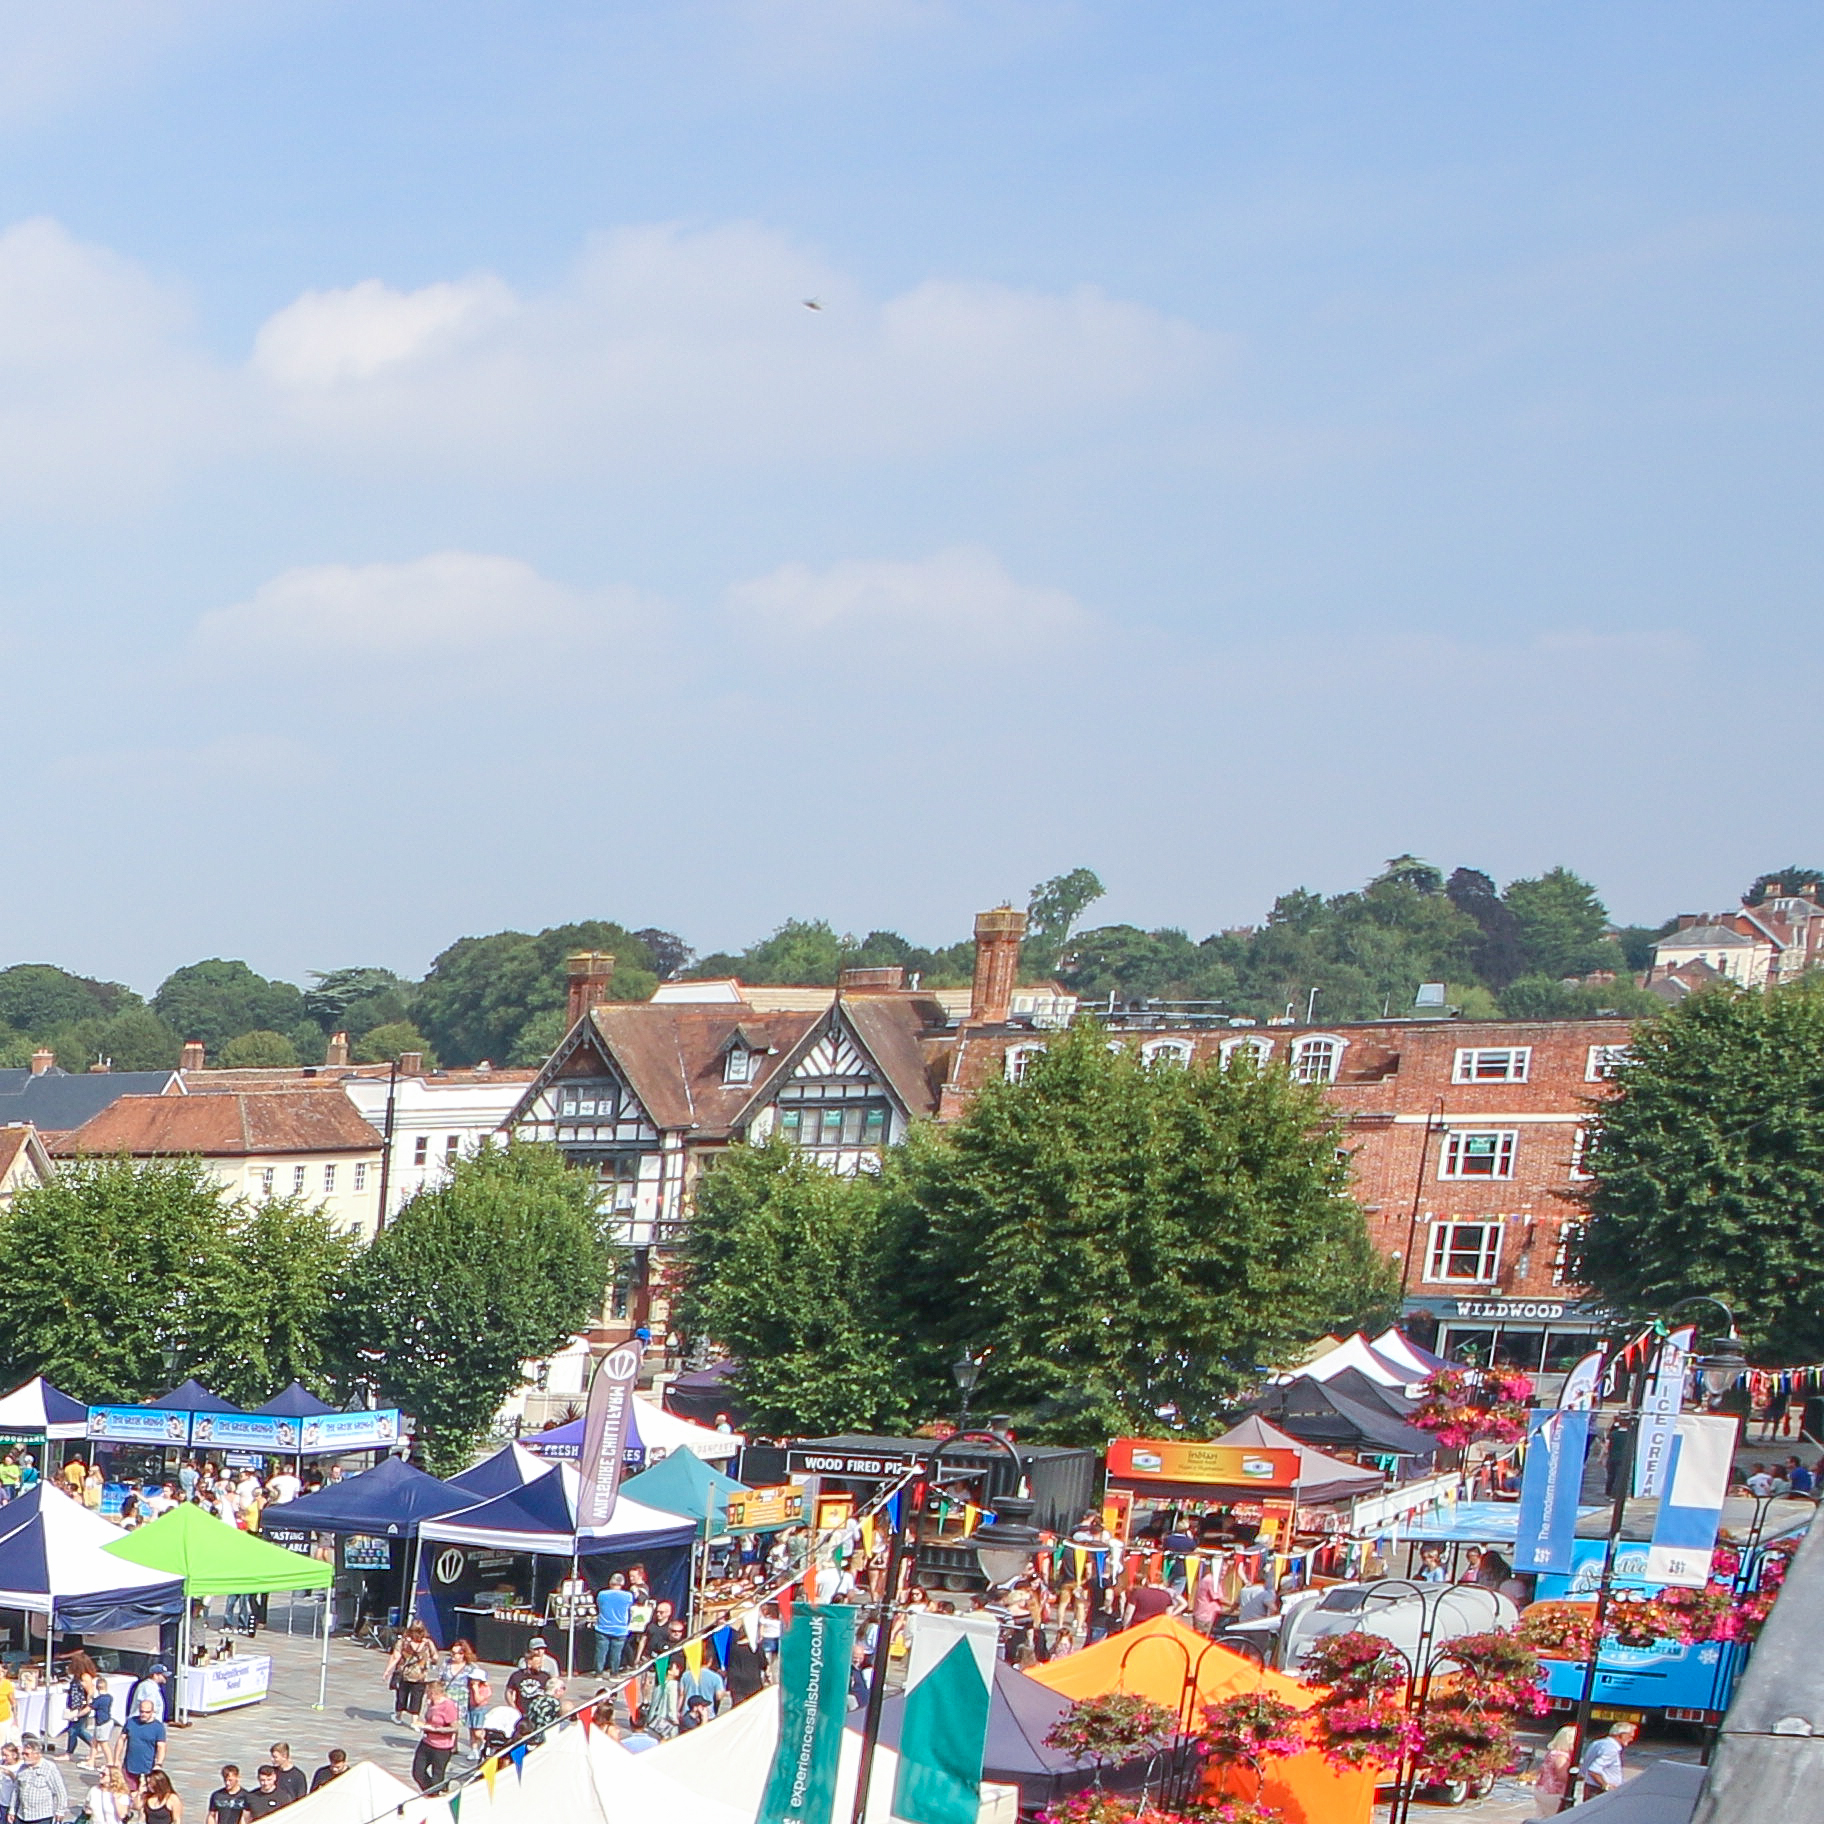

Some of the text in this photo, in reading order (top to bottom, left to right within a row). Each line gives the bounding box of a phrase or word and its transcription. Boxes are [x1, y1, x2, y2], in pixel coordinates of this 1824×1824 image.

[1456, 1302, 1563, 1319] WILDWOOD
[1654, 1384, 1671, 1427] ICE
[544, 1444, 580, 1458] FRESH
[1548, 1442, 1561, 1485] medieval
[805, 1456, 843, 1471] WOOD
[846, 1459, 881, 1474] FIRED
[1542, 1485, 1556, 1522] modern
[1538, 1523, 1551, 1541] The
[790, 1616, 824, 1809] experiencesalisbury.co.uk
